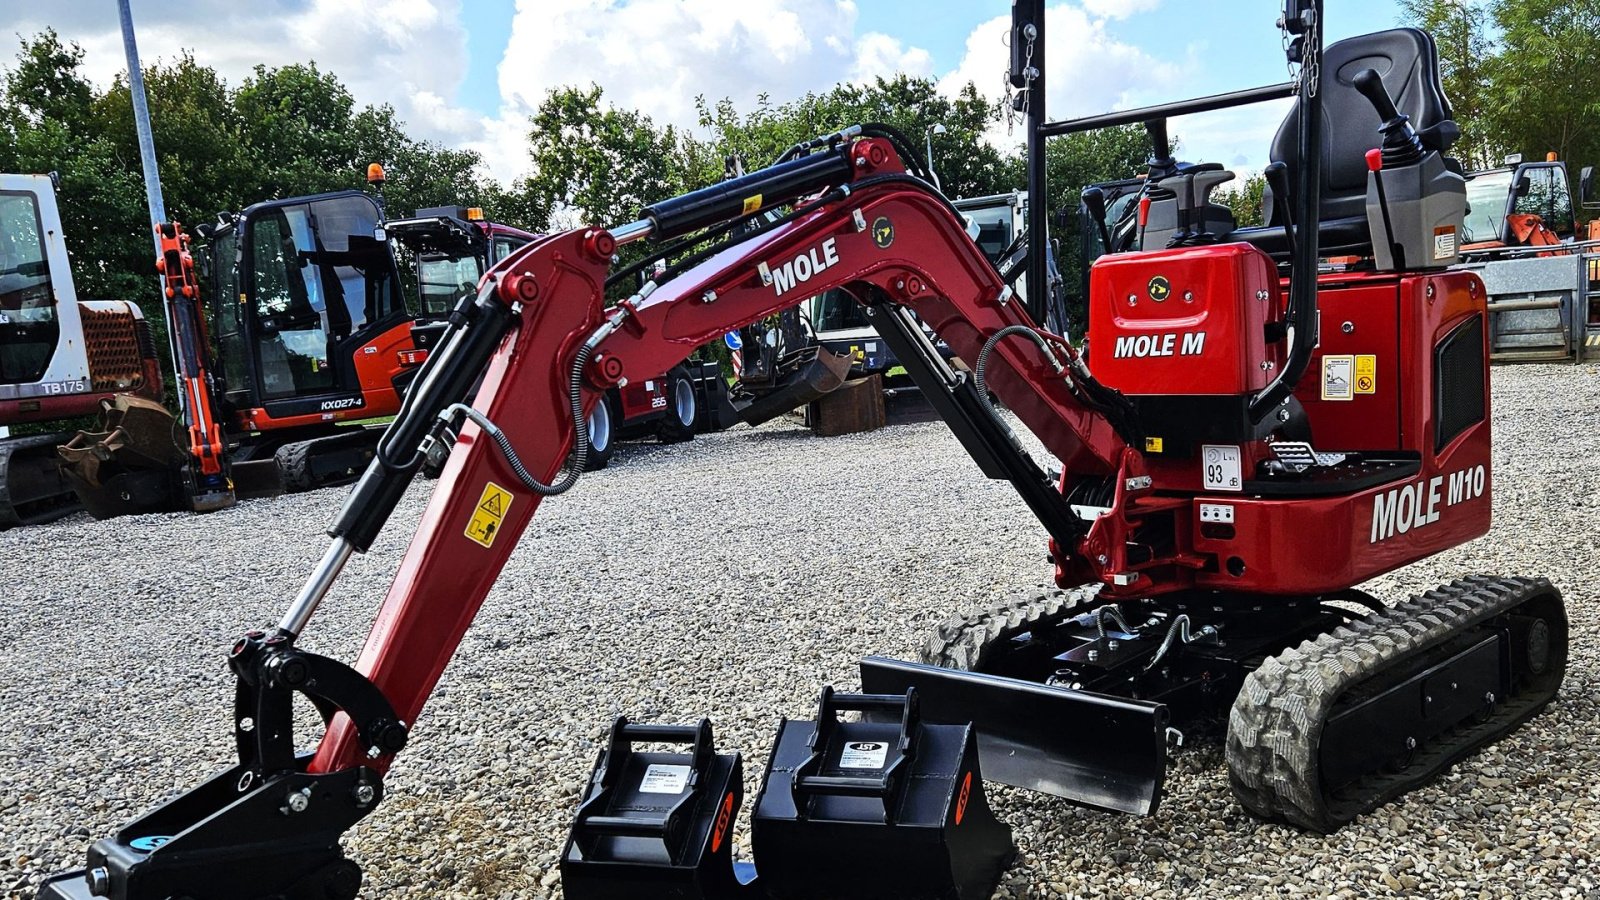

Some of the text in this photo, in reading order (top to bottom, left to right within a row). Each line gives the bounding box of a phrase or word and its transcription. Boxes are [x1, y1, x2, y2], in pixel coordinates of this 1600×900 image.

[772, 237, 839, 296] MOLE
[1114, 332, 1205, 358] MOLE M
[41, 380, 84, 394] TB175
[321, 398, 362, 410] KX027-4
[1208, 464, 1223, 484] 93
[1370, 464, 1485, 544] MOLE M10
